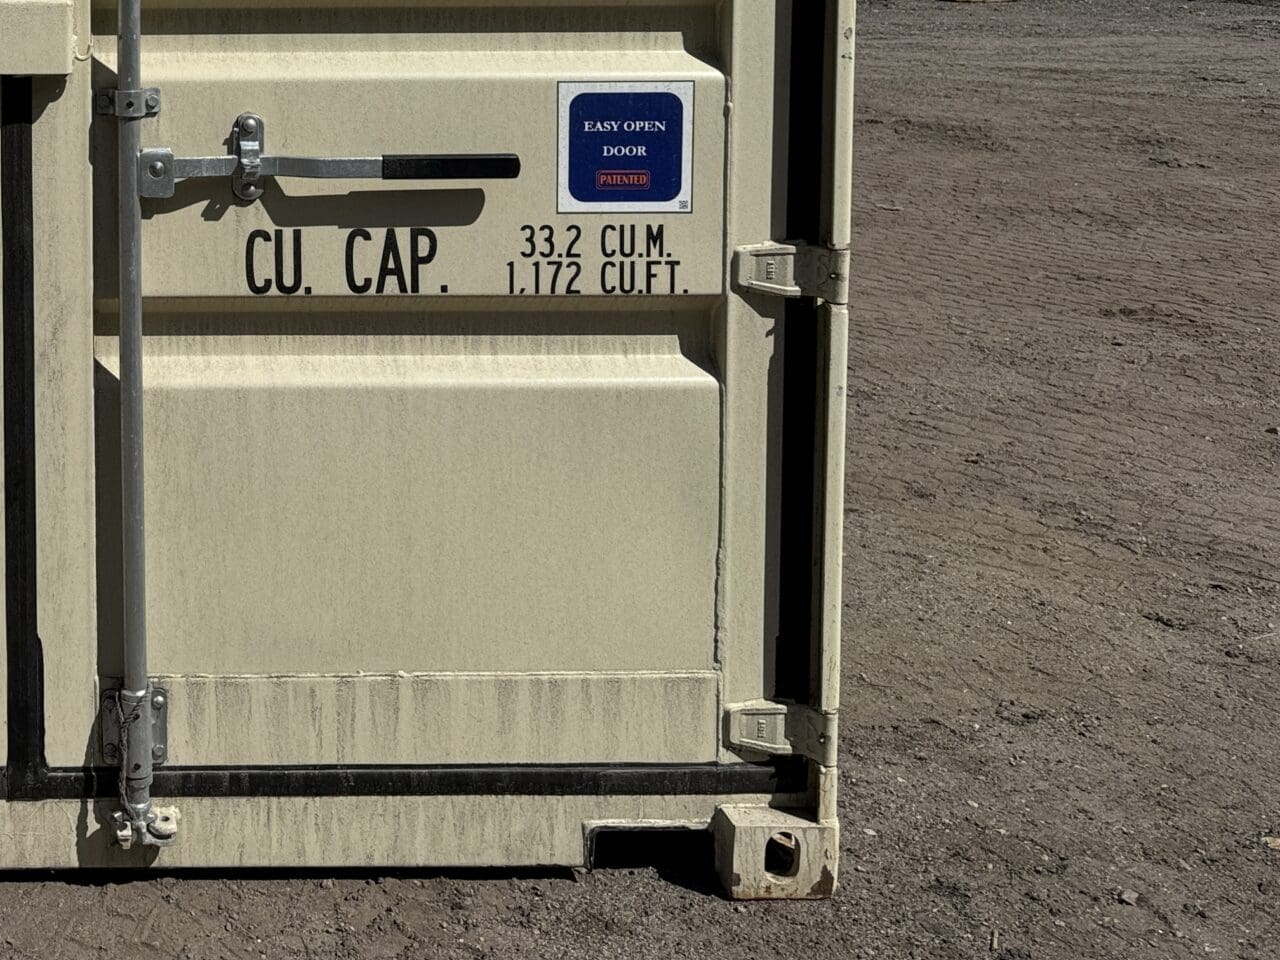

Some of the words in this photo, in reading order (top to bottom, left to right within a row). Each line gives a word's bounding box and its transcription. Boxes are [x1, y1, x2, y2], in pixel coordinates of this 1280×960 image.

[583, 120, 621, 132] EASY
[623, 120, 666, 132] OPEN
[602, 145, 647, 157] DOOR
[600, 174, 647, 185] PATENTED
[520, 224, 582, 258] 33.2
[245, 228, 312, 294] CU.
[344, 227, 449, 294] CAP.
[506, 260, 582, 294] 1,172
